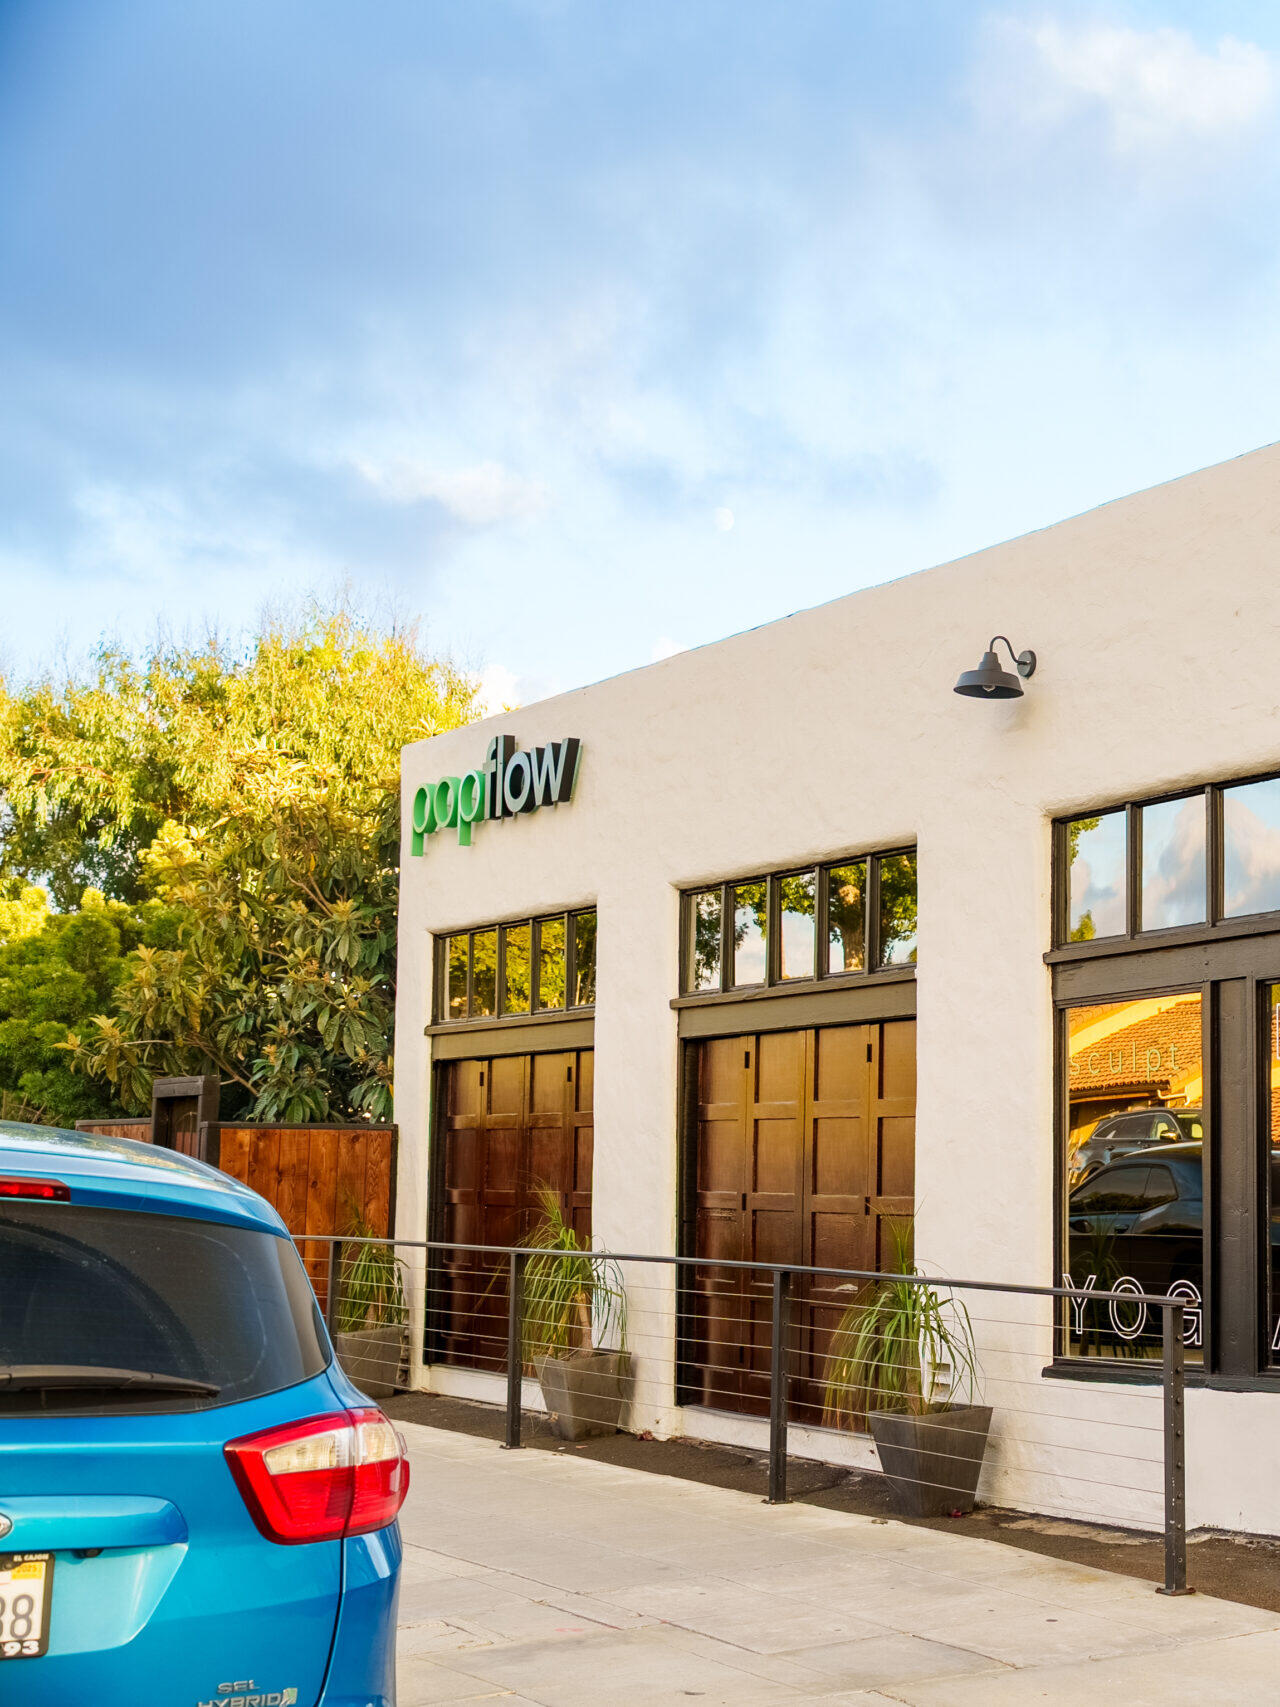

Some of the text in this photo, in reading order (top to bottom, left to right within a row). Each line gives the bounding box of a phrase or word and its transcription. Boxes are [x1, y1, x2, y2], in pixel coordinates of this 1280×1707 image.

[411, 734, 583, 857] popflow
[1069, 1041, 1181, 1080] sculpt
[217, 1680, 260, 1694] SEL
